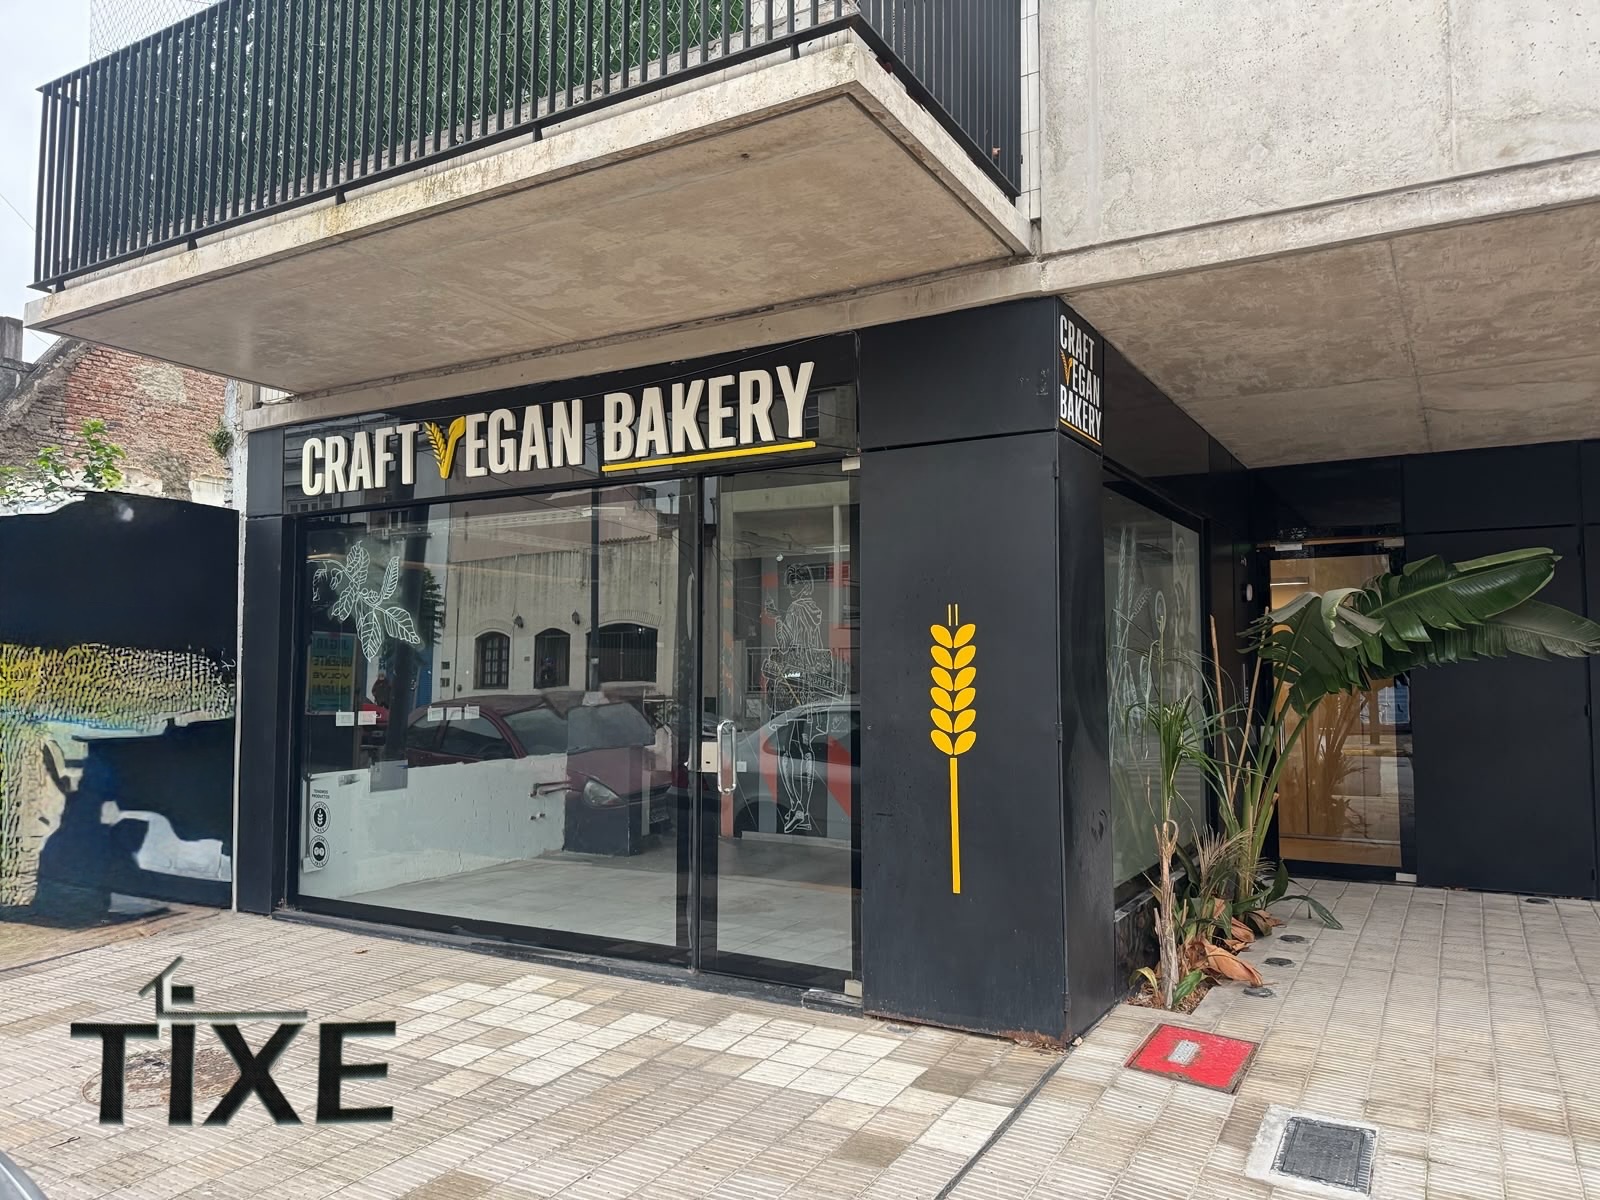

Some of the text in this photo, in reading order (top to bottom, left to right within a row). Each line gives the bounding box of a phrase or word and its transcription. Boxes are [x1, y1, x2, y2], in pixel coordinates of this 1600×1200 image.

[1060, 314, 1095, 371] CRAFT
[301, 422, 420, 496] CRAFT
[602, 361, 816, 463] BAKERY
[1060, 384, 1102, 441] BAKERY
